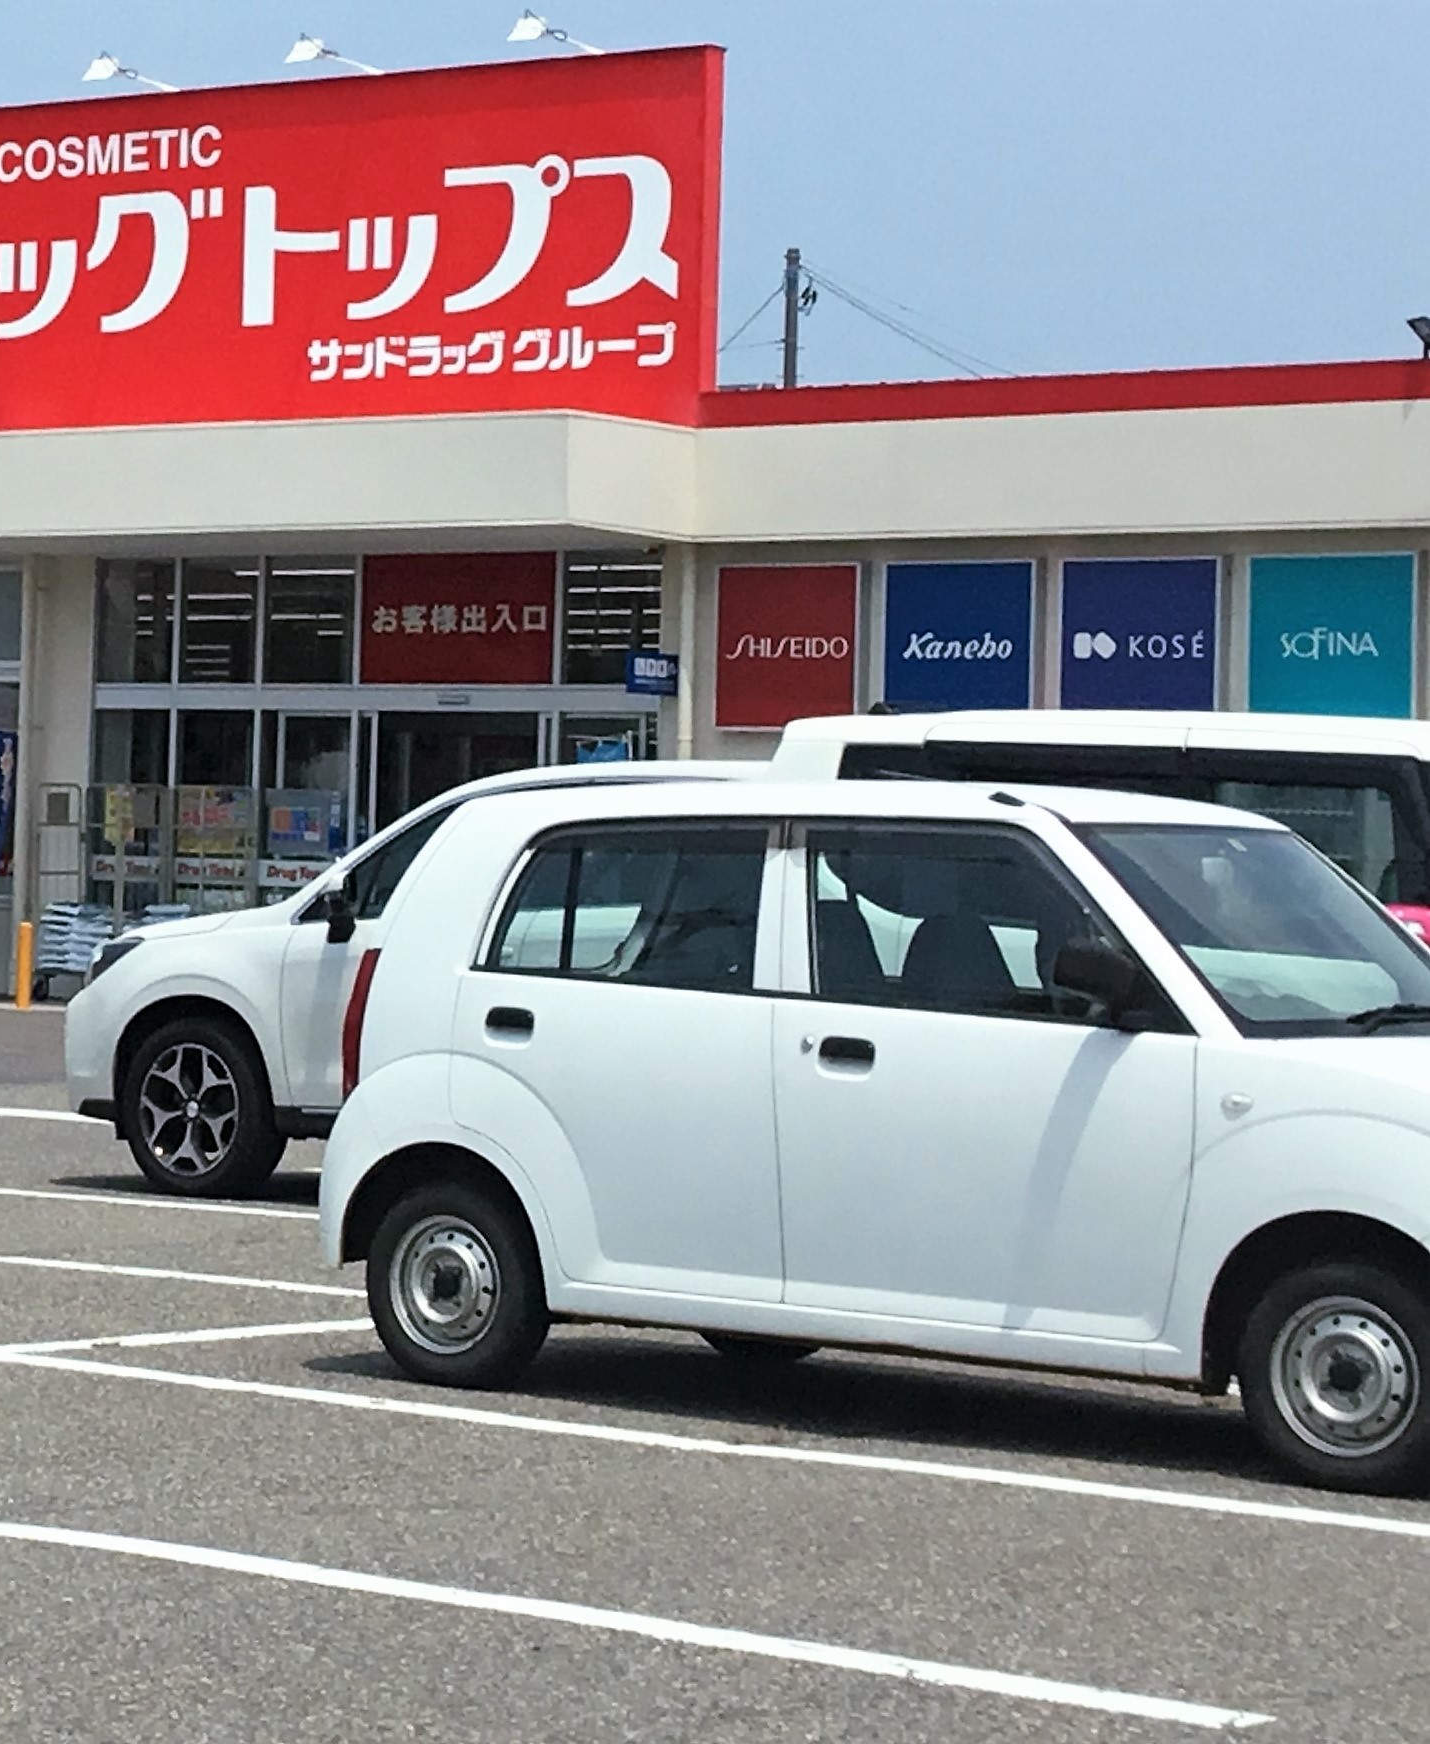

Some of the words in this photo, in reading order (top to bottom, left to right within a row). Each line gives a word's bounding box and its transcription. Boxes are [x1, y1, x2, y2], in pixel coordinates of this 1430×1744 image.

[371, 603, 547, 634] お客様出入口
[725, 634, 850, 660] SHISEIDO
[901, 632, 1013, 660] Kanebo
[1128, 630, 1204, 659] KOSÉ
